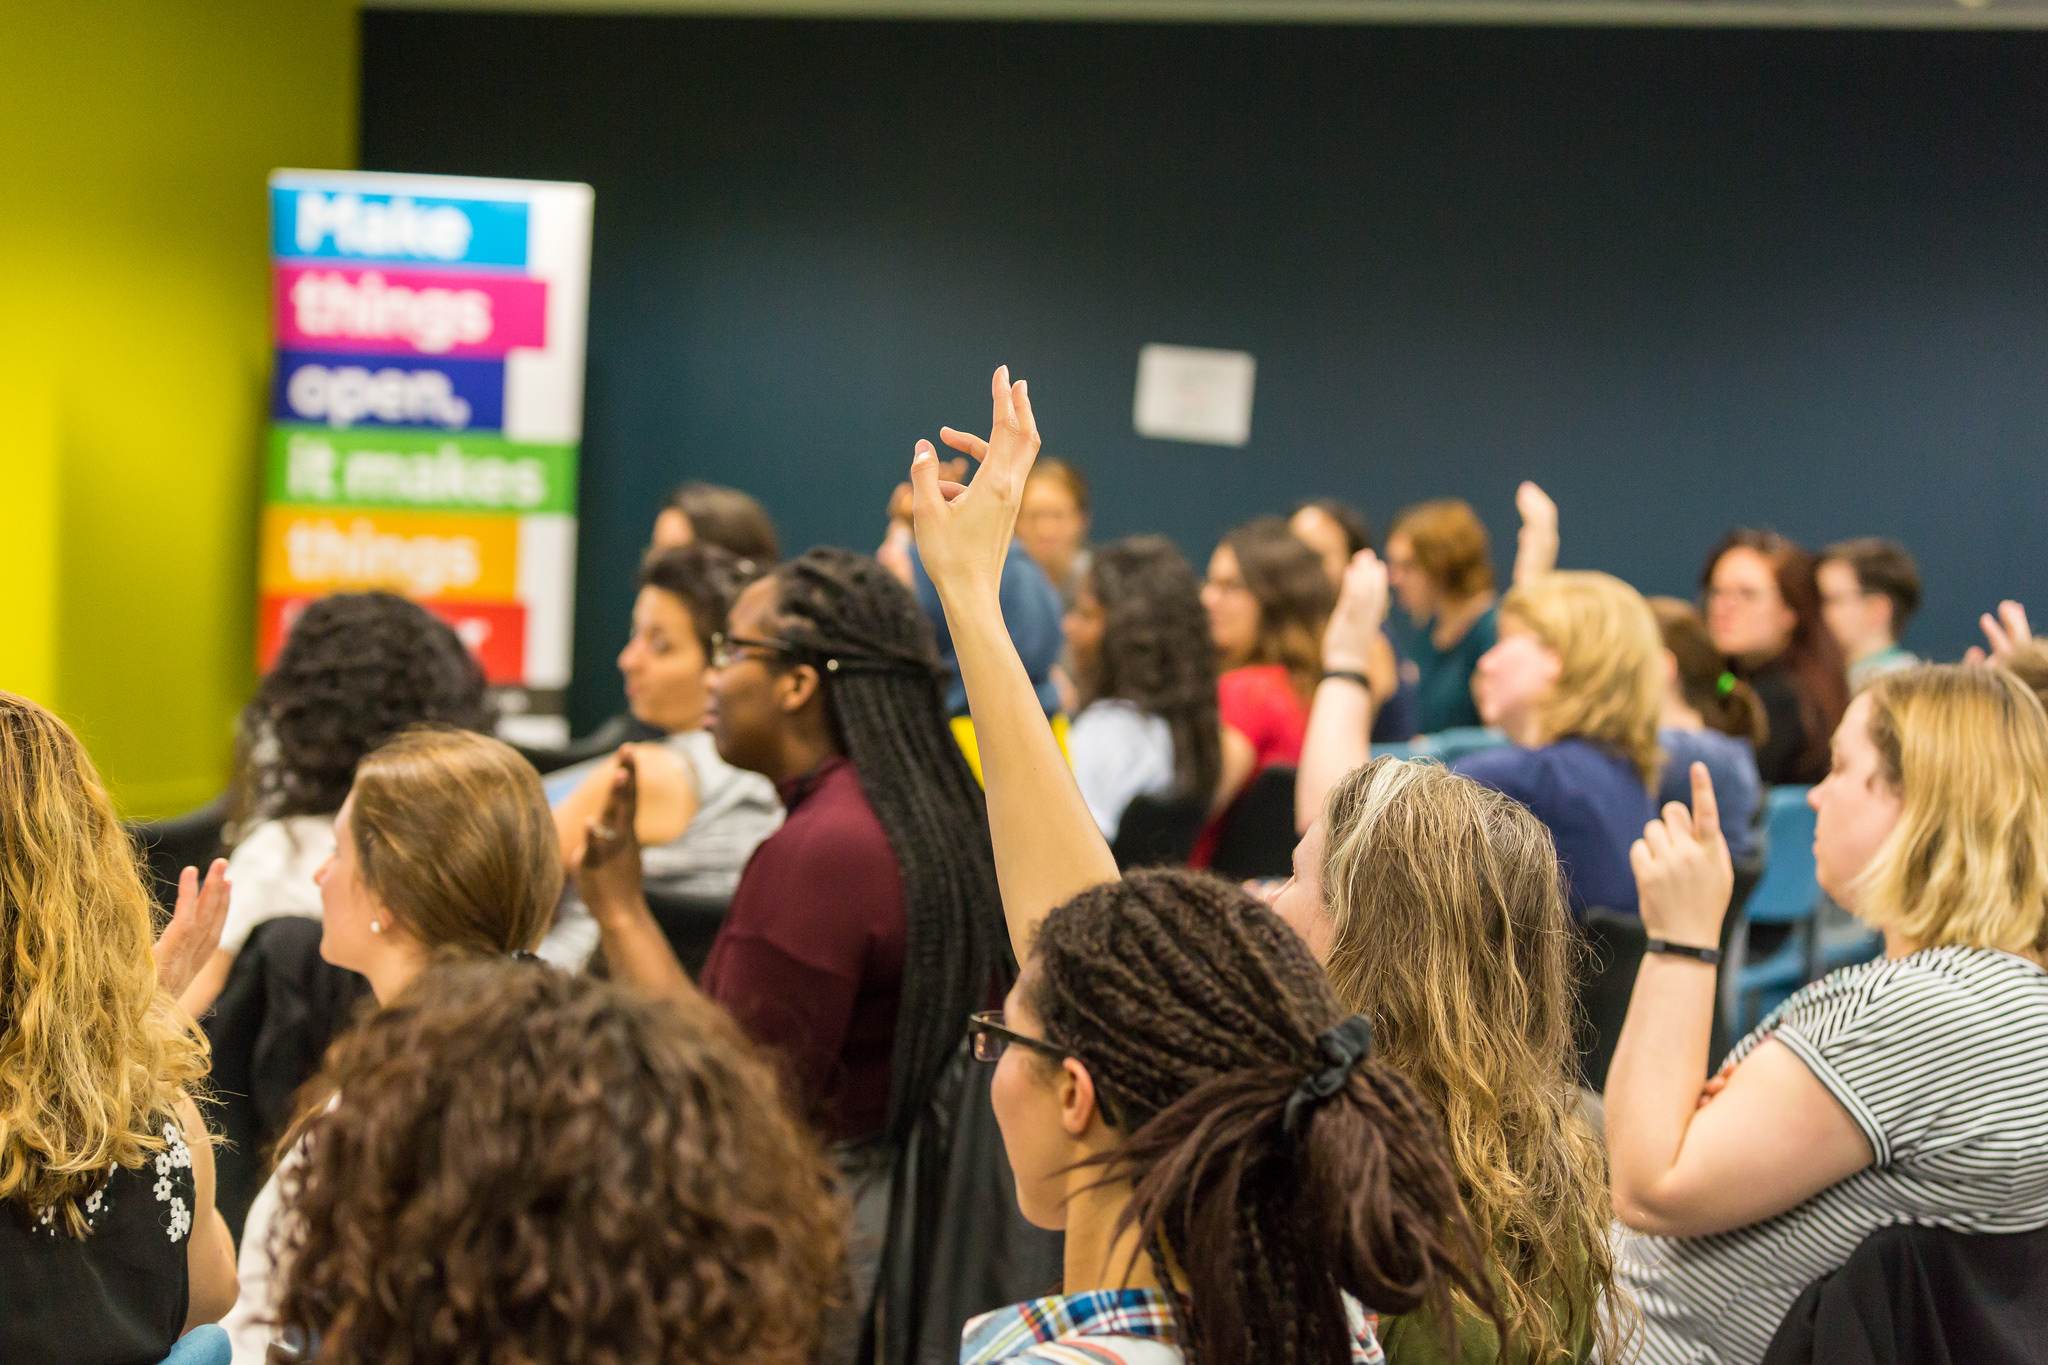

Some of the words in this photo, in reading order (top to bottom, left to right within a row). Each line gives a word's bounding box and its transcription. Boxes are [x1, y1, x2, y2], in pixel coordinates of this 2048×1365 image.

[296, 190, 472, 260] Make
[290, 269, 494, 354] things
[286, 433, 334, 500] it
[344, 442, 546, 507] makes
[284, 516, 482, 596] things
